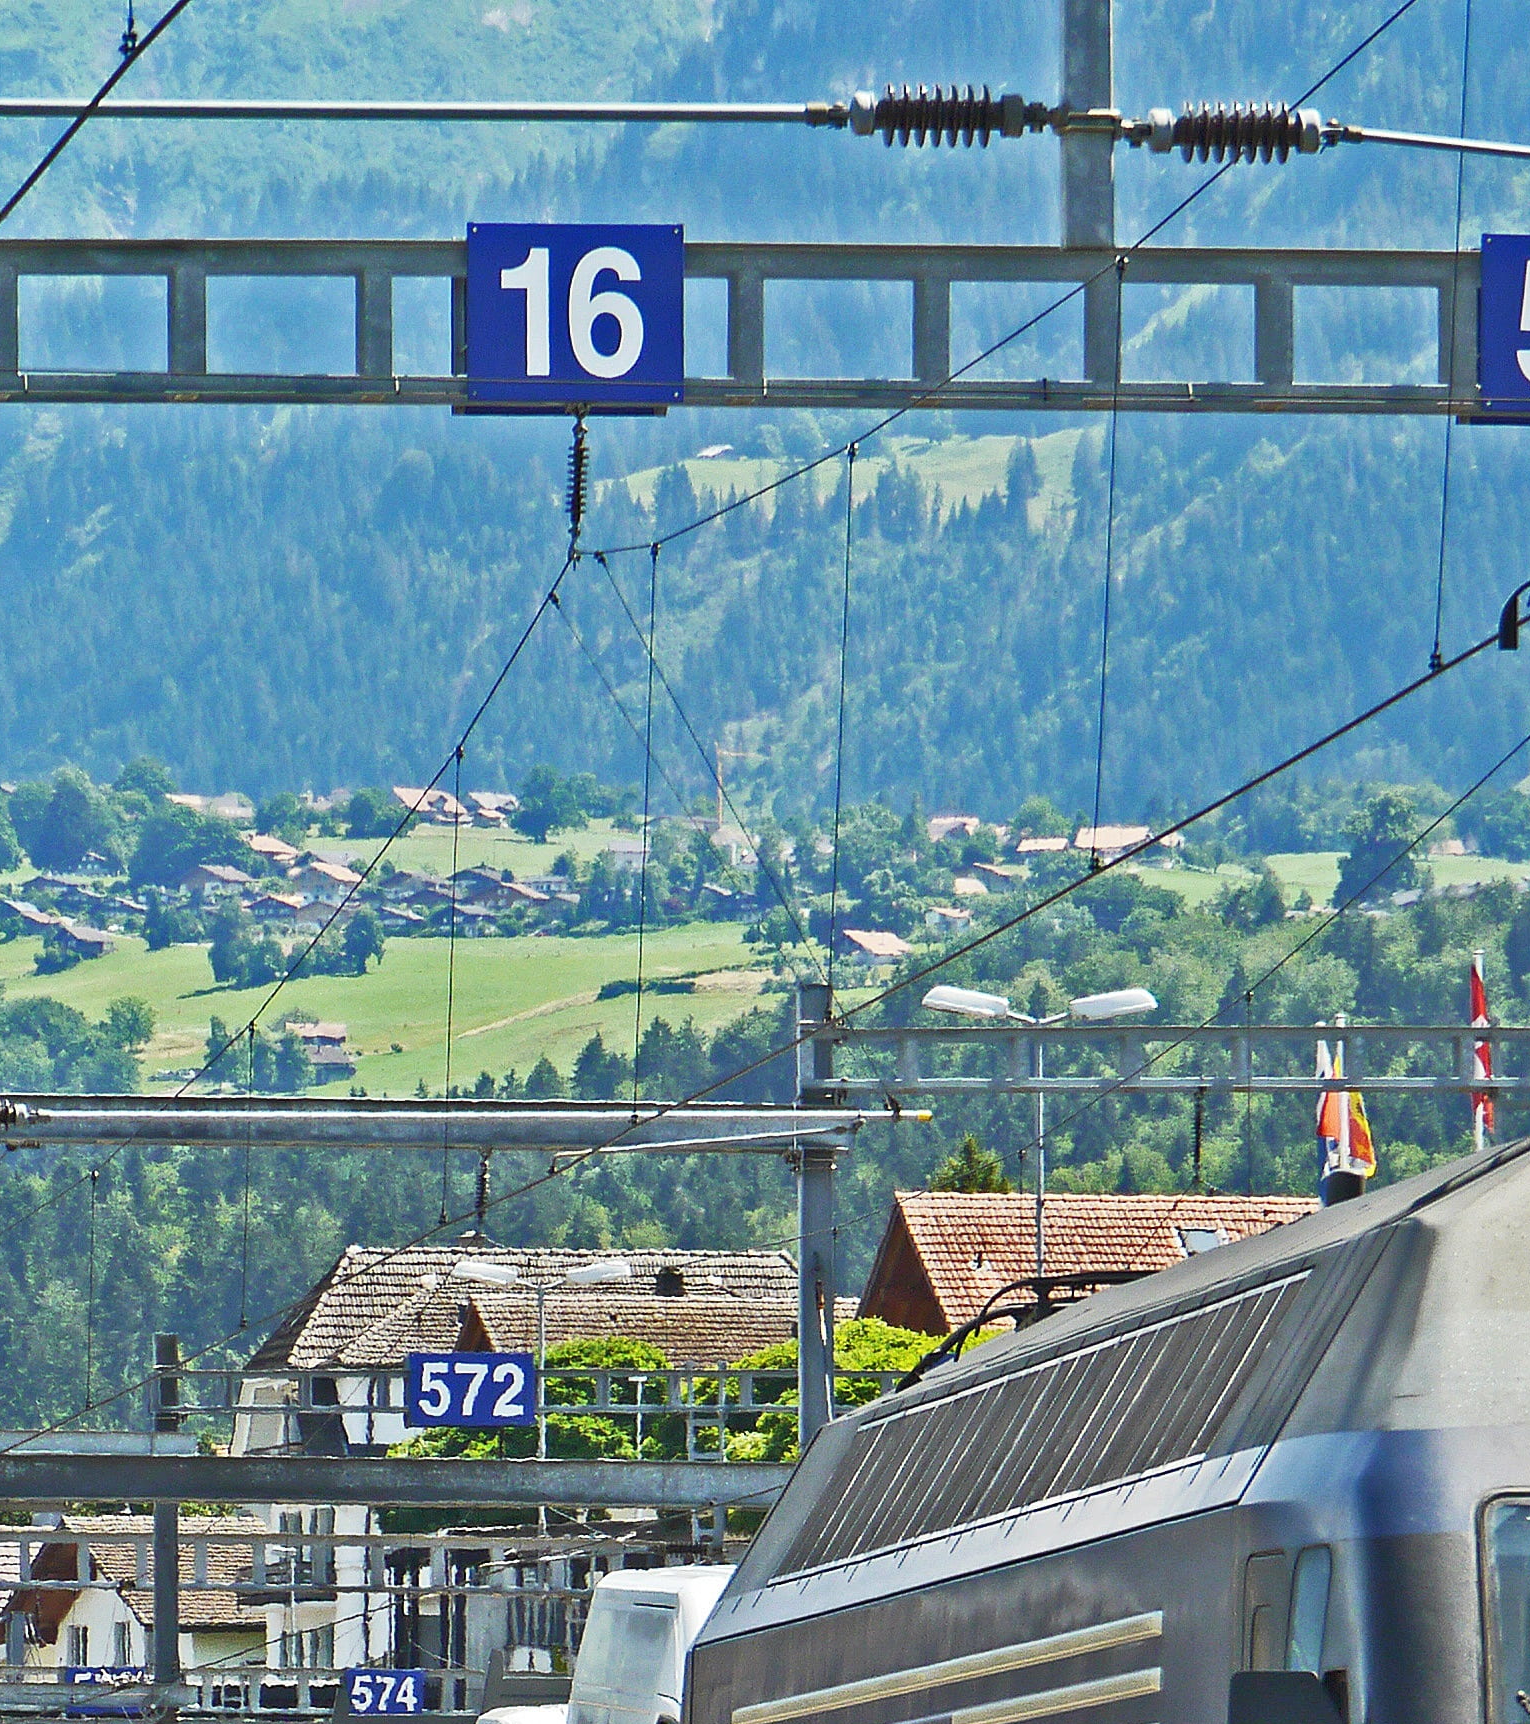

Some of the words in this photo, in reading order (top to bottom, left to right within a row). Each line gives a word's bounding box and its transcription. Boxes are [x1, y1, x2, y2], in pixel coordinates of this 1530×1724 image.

[500, 246, 644, 378] 16
[418, 1362, 525, 1417] 572
[351, 1675, 418, 1712] 574
